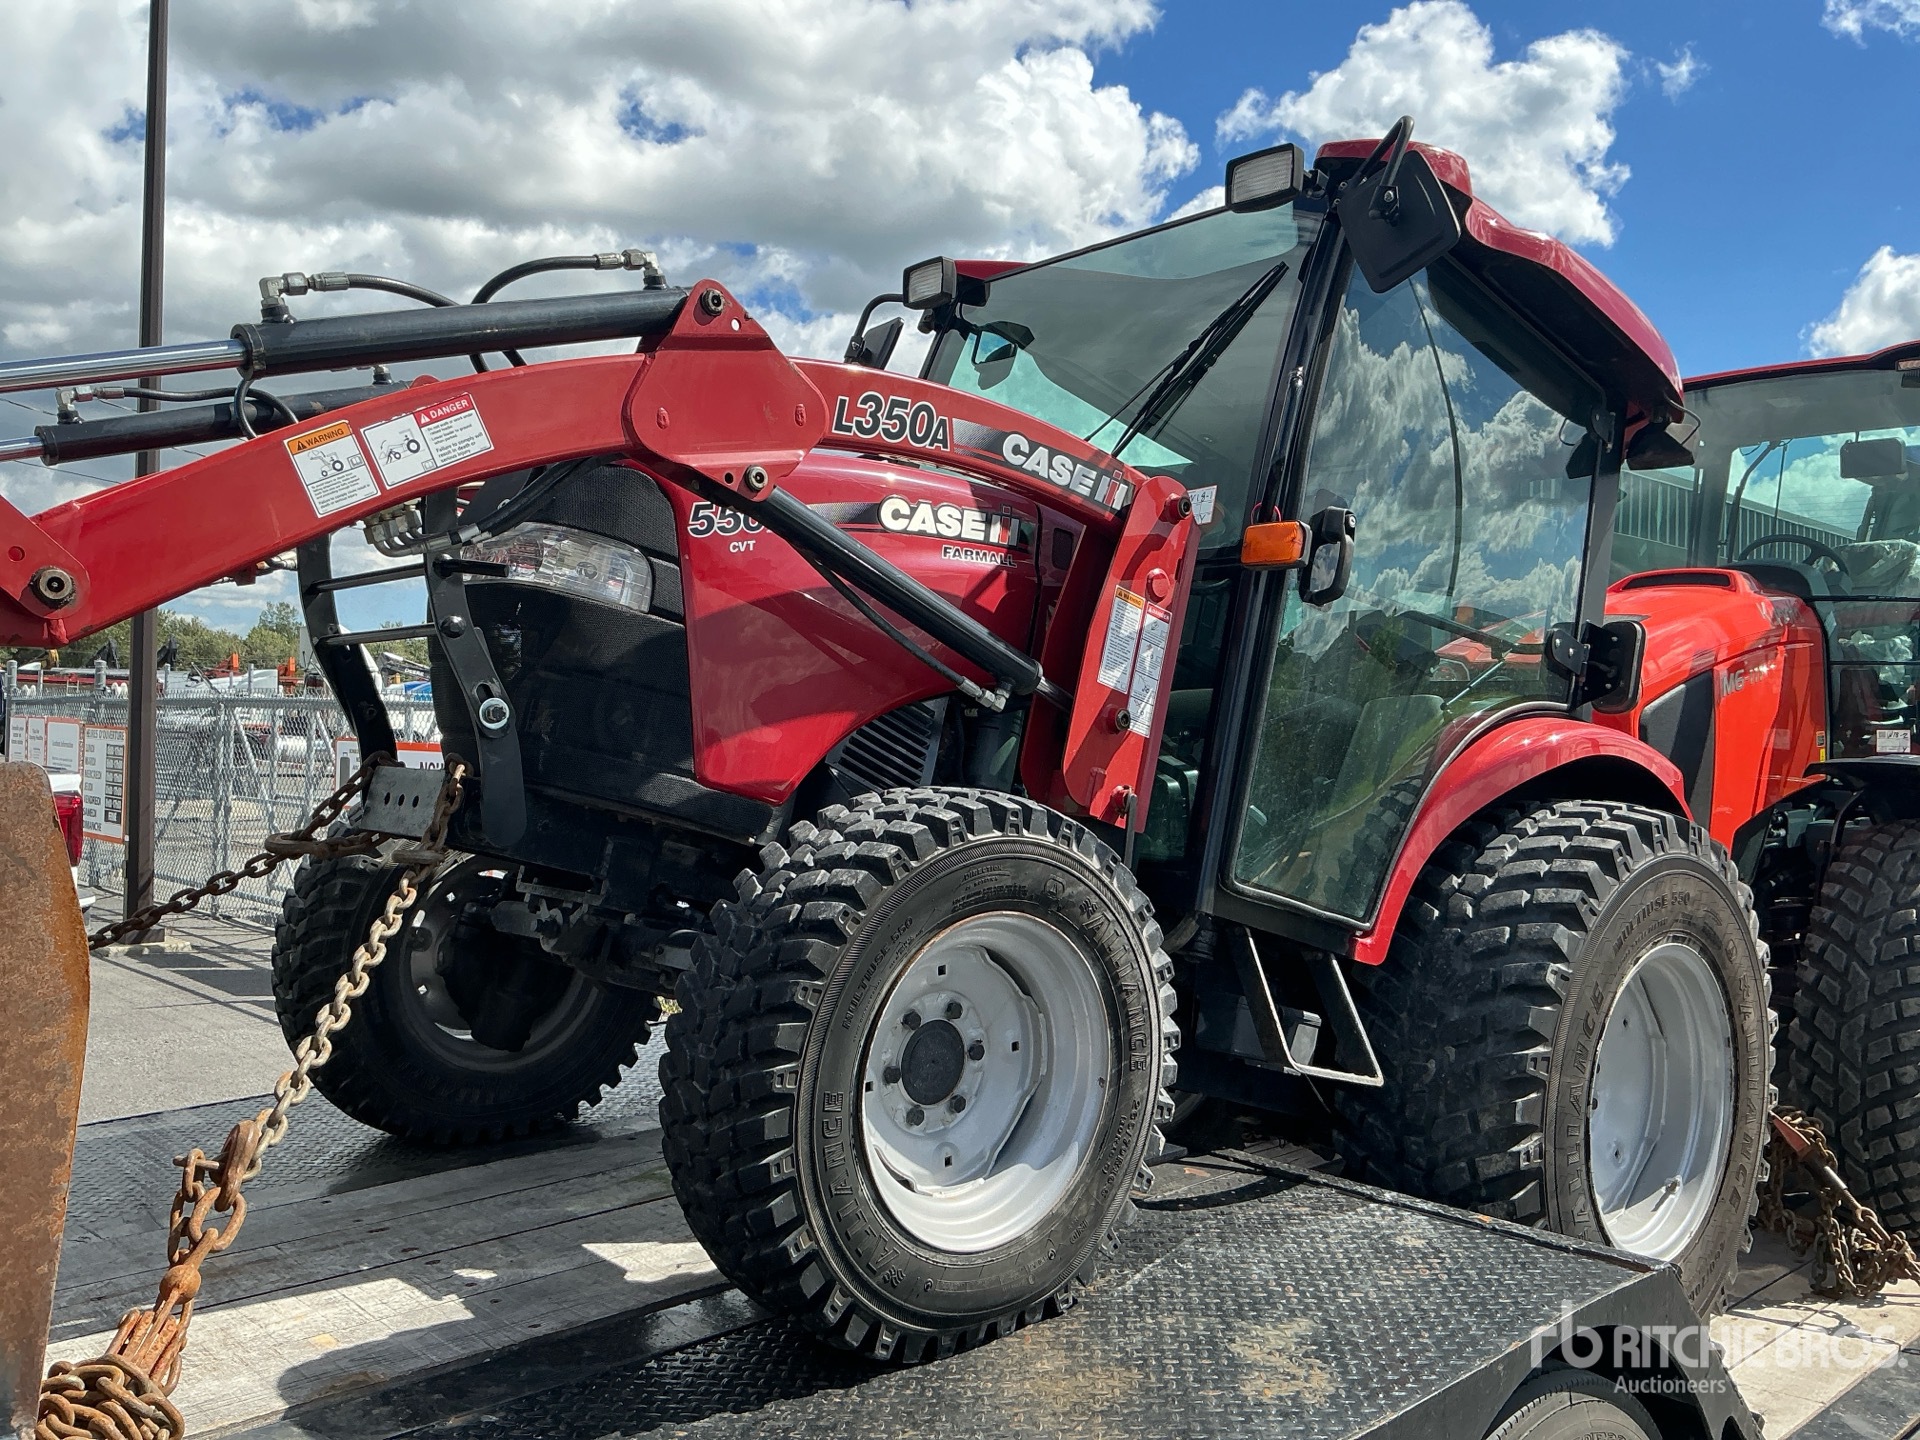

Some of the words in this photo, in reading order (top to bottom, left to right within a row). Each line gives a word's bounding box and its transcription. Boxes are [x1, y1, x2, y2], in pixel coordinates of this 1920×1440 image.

[305, 429, 344, 446] WARNING
[429, 399, 469, 419] DANGER
[832, 391, 950, 451] L350A
[1002, 433, 1097, 498] CASE
[729, 541, 756, 553] CVT
[879, 495, 986, 541] CASE
[942, 545, 1018, 568] FARMALL
[1671, 891, 1691, 906] 550
[842, 942, 891, 1030] MULTIUSE
[890, 916, 913, 943] 550
[1082, 911, 1147, 1072] ALLIANCE
[1567, 983, 1604, 1225] ALLIANCE
[1729, 1002, 1755, 1212] ALLIANCE
[822, 1091, 900, 1274] ALLIANCE
